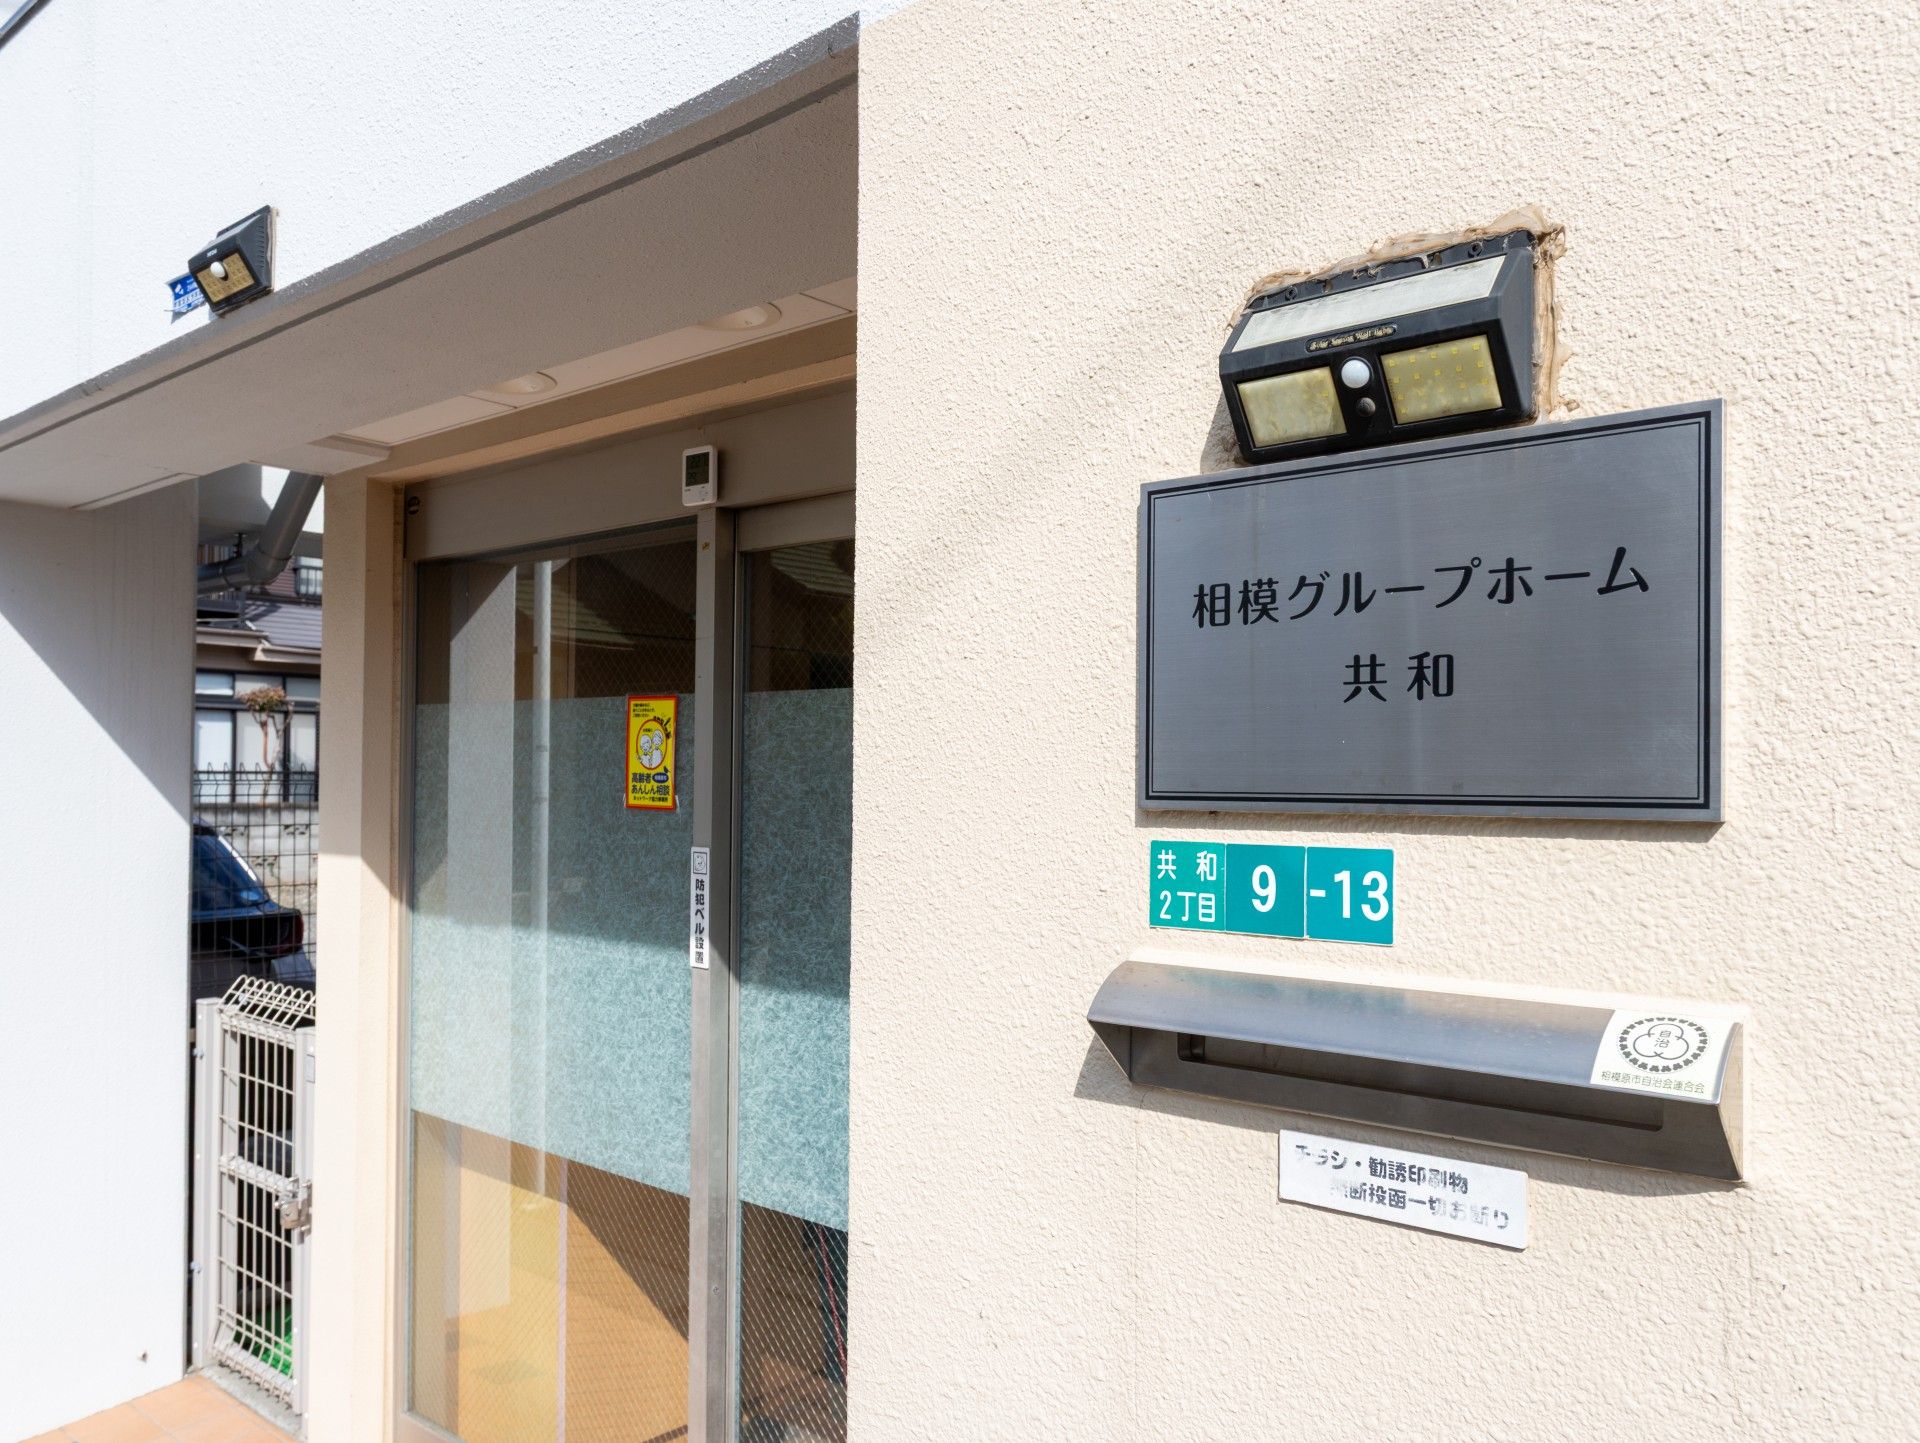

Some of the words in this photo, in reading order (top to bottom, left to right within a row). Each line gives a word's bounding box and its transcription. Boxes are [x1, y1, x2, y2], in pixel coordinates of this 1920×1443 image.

[1192, 546, 1650, 629] 相模グループホーム
[1343, 651, 1454, 703] 共和
[1156, 849, 1217, 882] 共和
[1159, 890, 1216, 923] 2丁目
[1251, 864, 1276, 913] 9
[1309, 869, 1389, 922] -13
[694, 878, 705, 965] 防犯ベル設置
[1654, 1030, 1671, 1048] 自治
[1600, 1070, 1705, 1094] 相模原市自治会連合会
[1331, 1179, 1509, 1230] 断投函一切お断り
